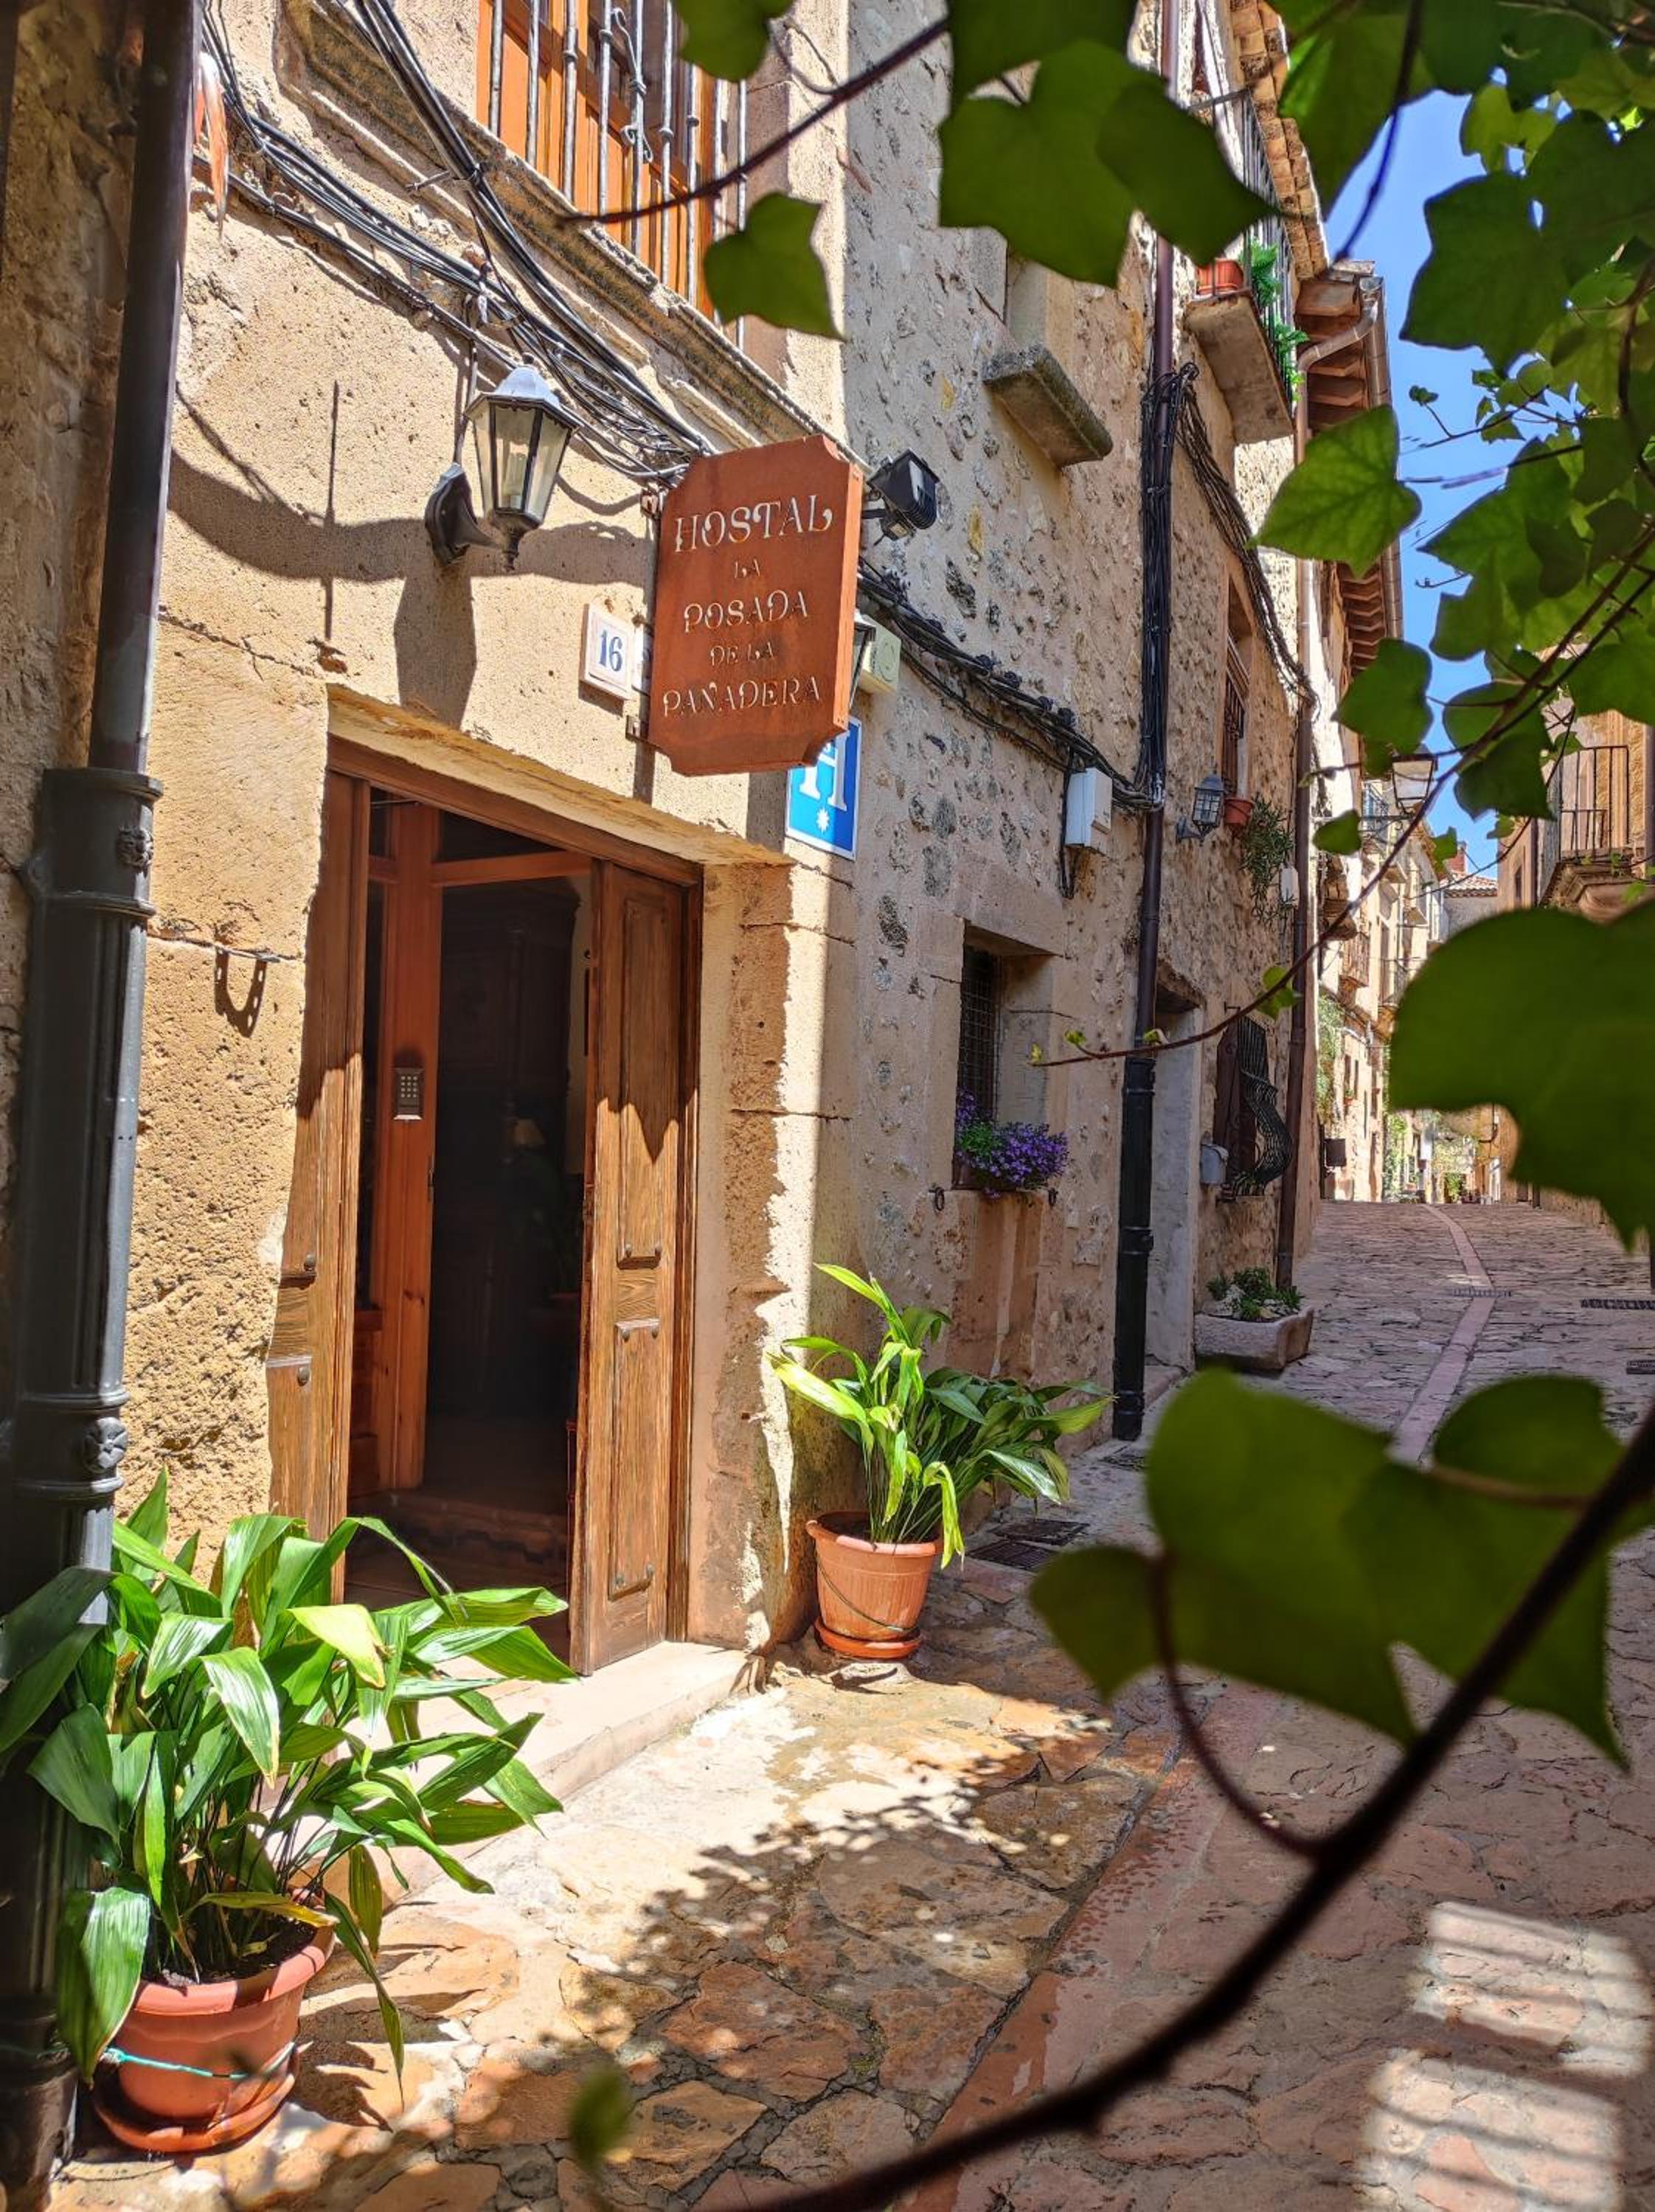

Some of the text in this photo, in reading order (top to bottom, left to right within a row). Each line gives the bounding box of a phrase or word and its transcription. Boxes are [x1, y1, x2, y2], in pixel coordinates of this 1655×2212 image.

[675, 495, 833, 552] HOSTAL
[734, 558, 761, 579] LA
[684, 589, 808, 633] POSADA
[599, 629, 623, 672] 16
[709, 641, 774, 667] DE LA
[663, 675, 821, 717] PANADERA
